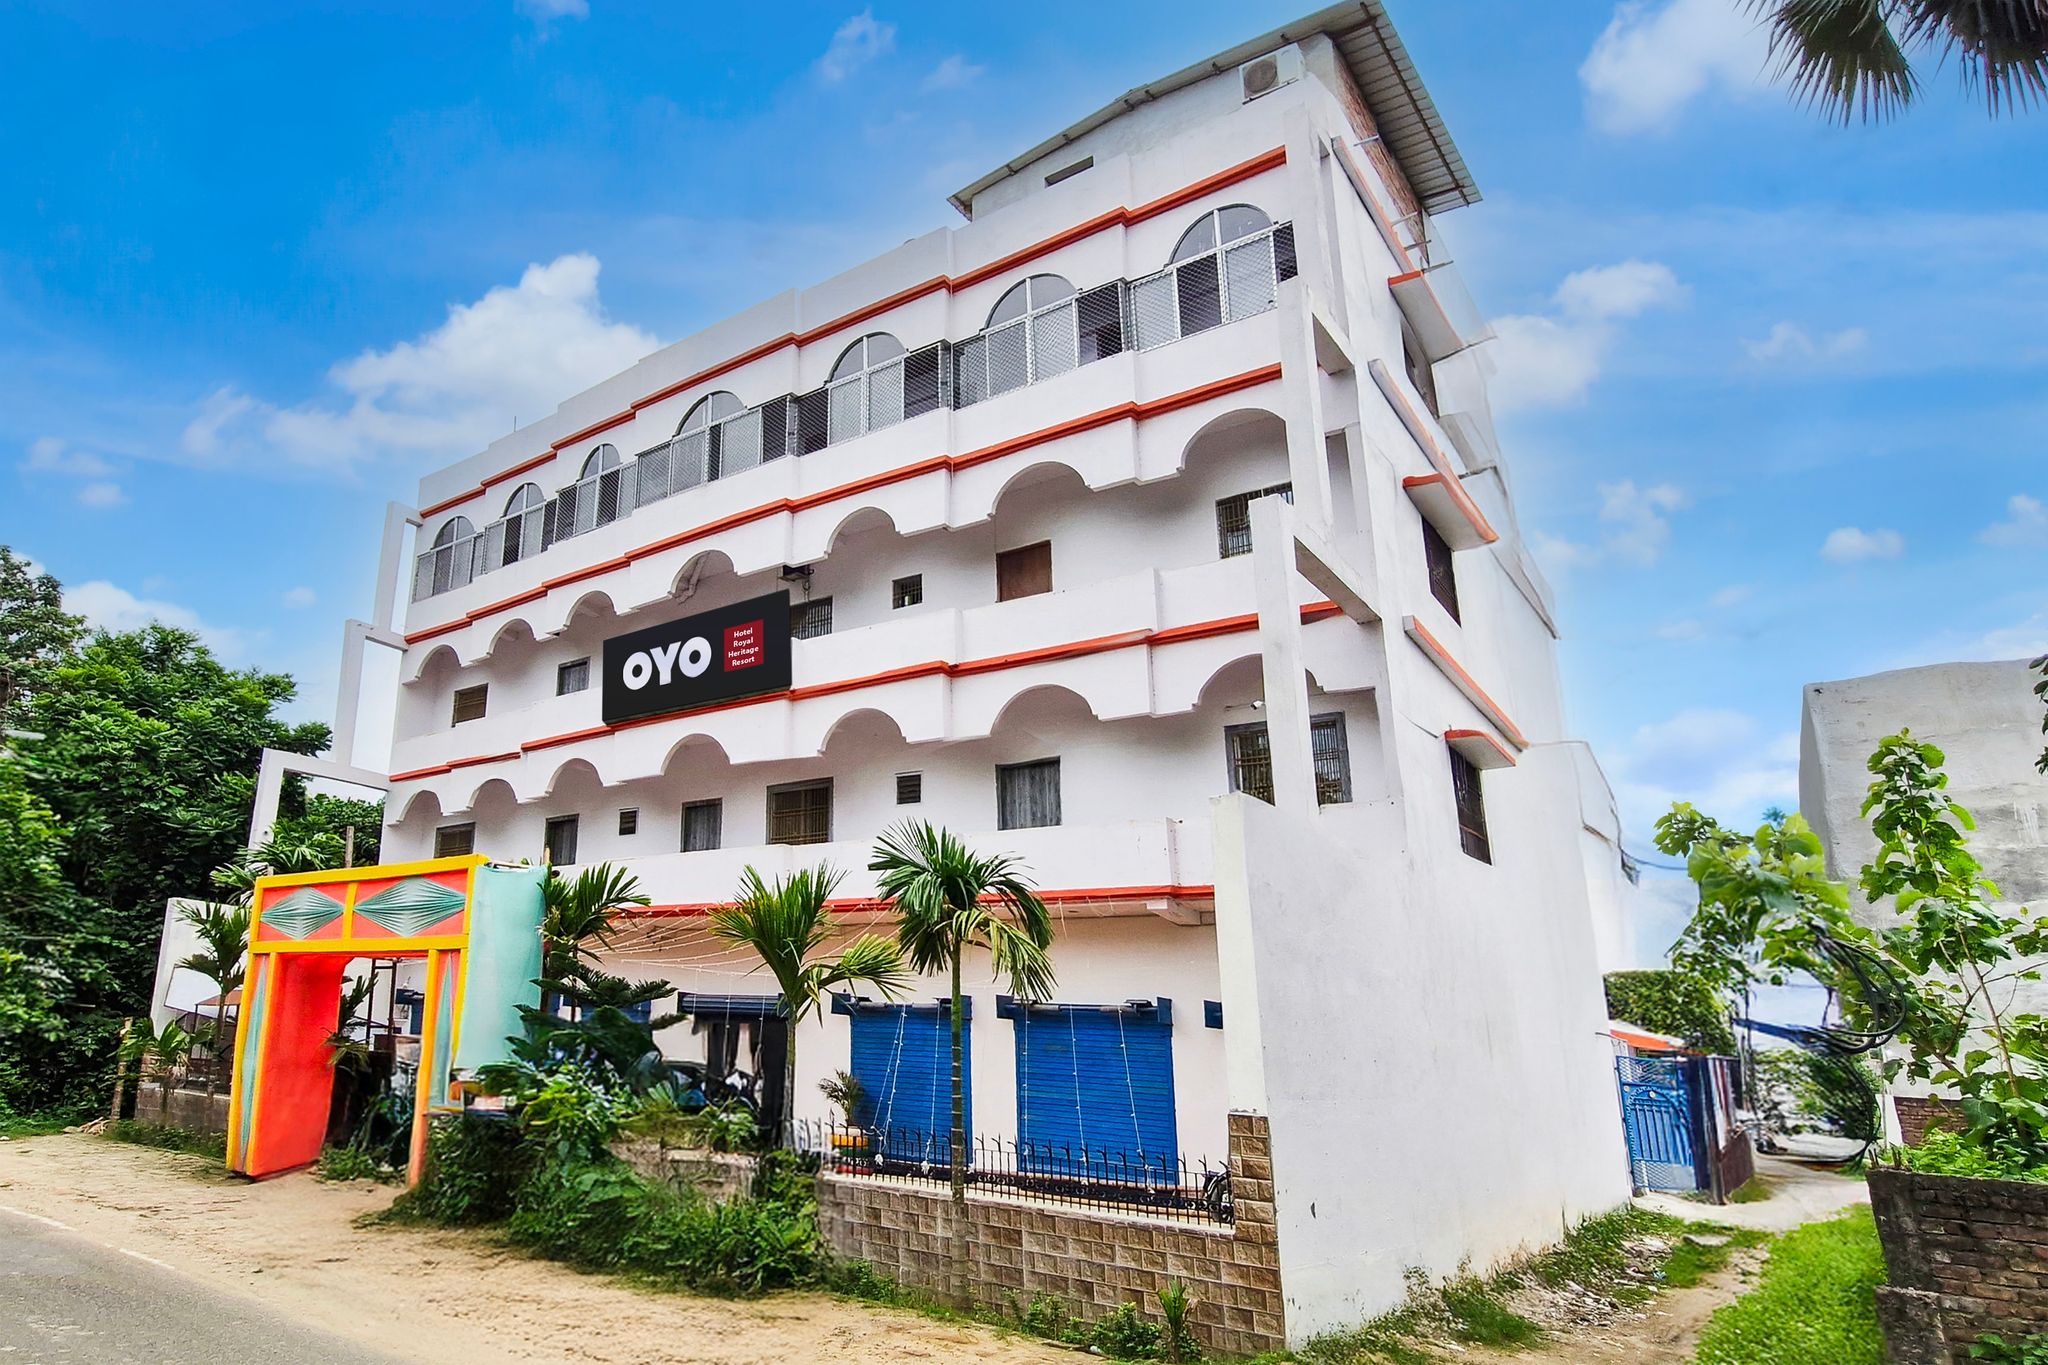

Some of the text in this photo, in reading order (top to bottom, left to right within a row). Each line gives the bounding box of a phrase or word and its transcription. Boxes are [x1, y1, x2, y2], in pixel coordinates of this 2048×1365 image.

[733, 627, 753, 638] Hotel
[733, 636, 754, 648] Royal
[728, 646, 759, 658] Heritage
[622, 636, 712, 691] OYO
[732, 656, 755, 667] Resort
